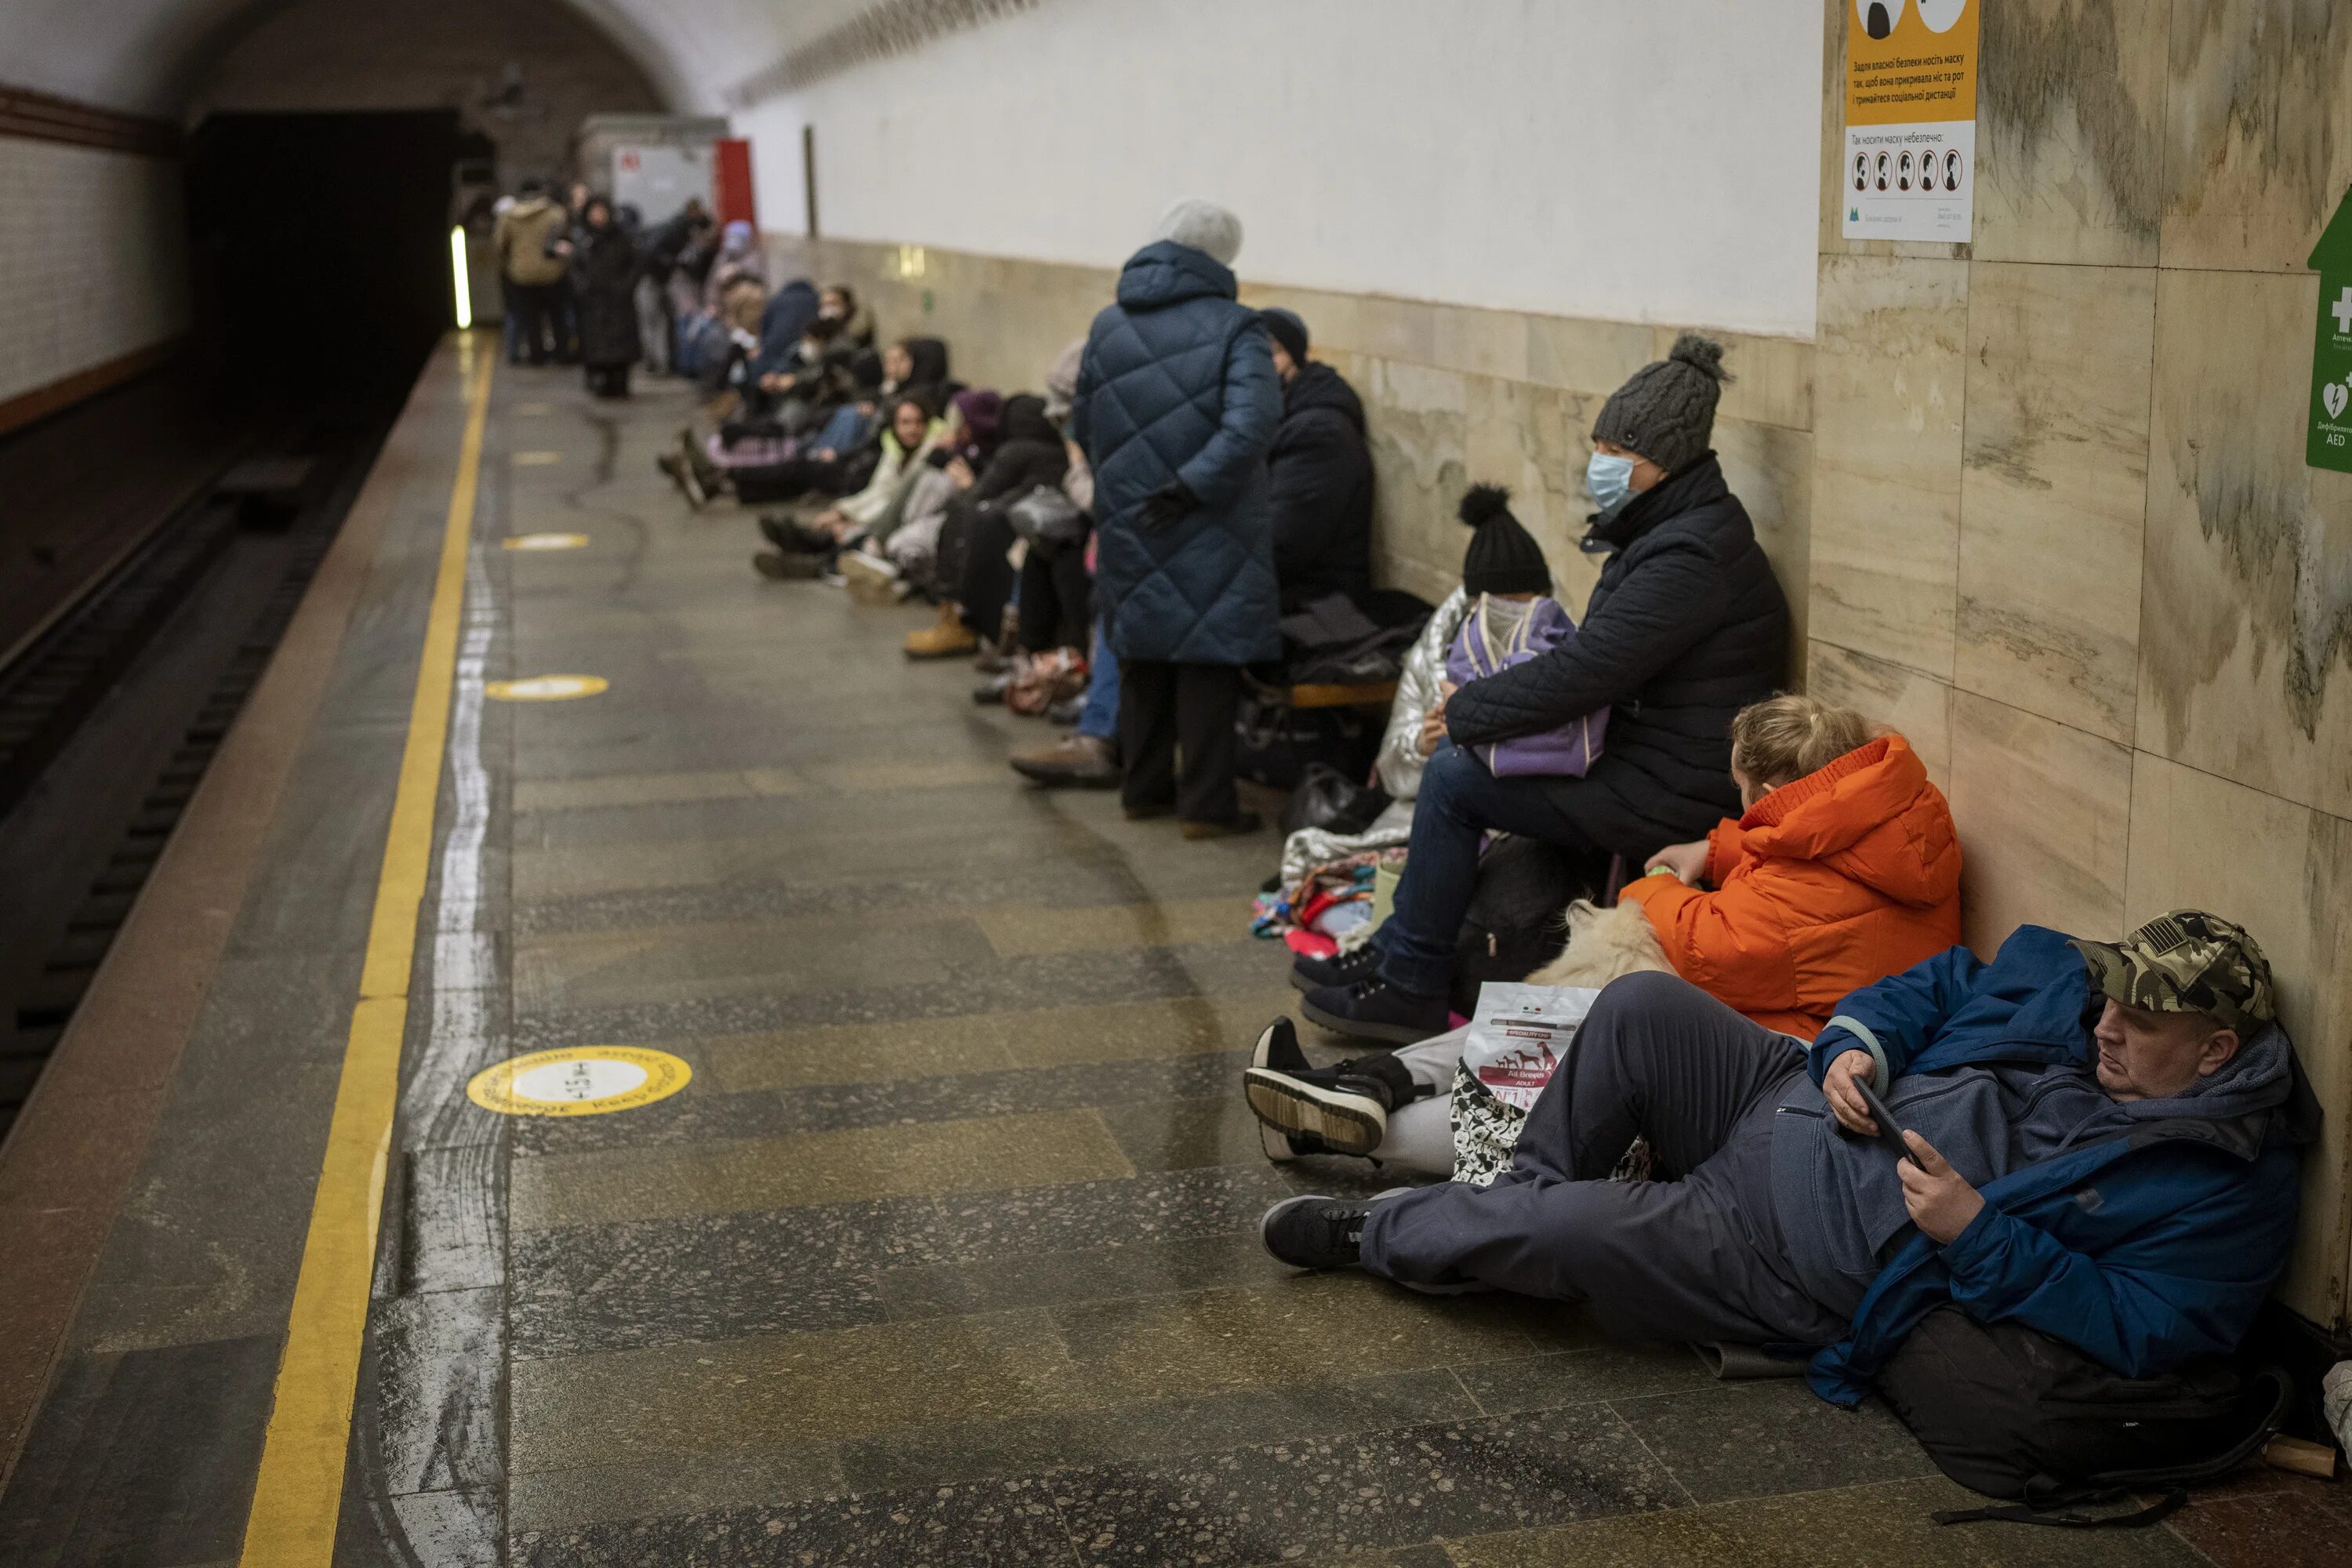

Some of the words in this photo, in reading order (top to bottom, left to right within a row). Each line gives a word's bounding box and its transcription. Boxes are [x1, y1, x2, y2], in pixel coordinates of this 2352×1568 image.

[1853, 61, 1871, 72] Задля
[1872, 58, 1895, 70] власної
[1896, 56, 1922, 68] безпеки
[1923, 54, 1944, 66] носіть
[1944, 54, 1964, 66] маску
[1865, 75, 1878, 88] щоб
[1895, 74, 1932, 88] прикривала
[1933, 71, 1943, 82] ніс
[1944, 73, 1951, 82] та
[1952, 71, 1965, 84] рот
[1856, 93, 1890, 107] тримайтеся
[1891, 89, 1925, 103] соціальної
[1926, 87, 1956, 101] дистанції
[1852, 134, 1861, 145] Так
[1862, 136, 1883, 145] носити
[1885, 135, 1903, 147] маску
[1904, 132, 1944, 143] небезпечно:
[2326, 434, 2345, 446] AED
